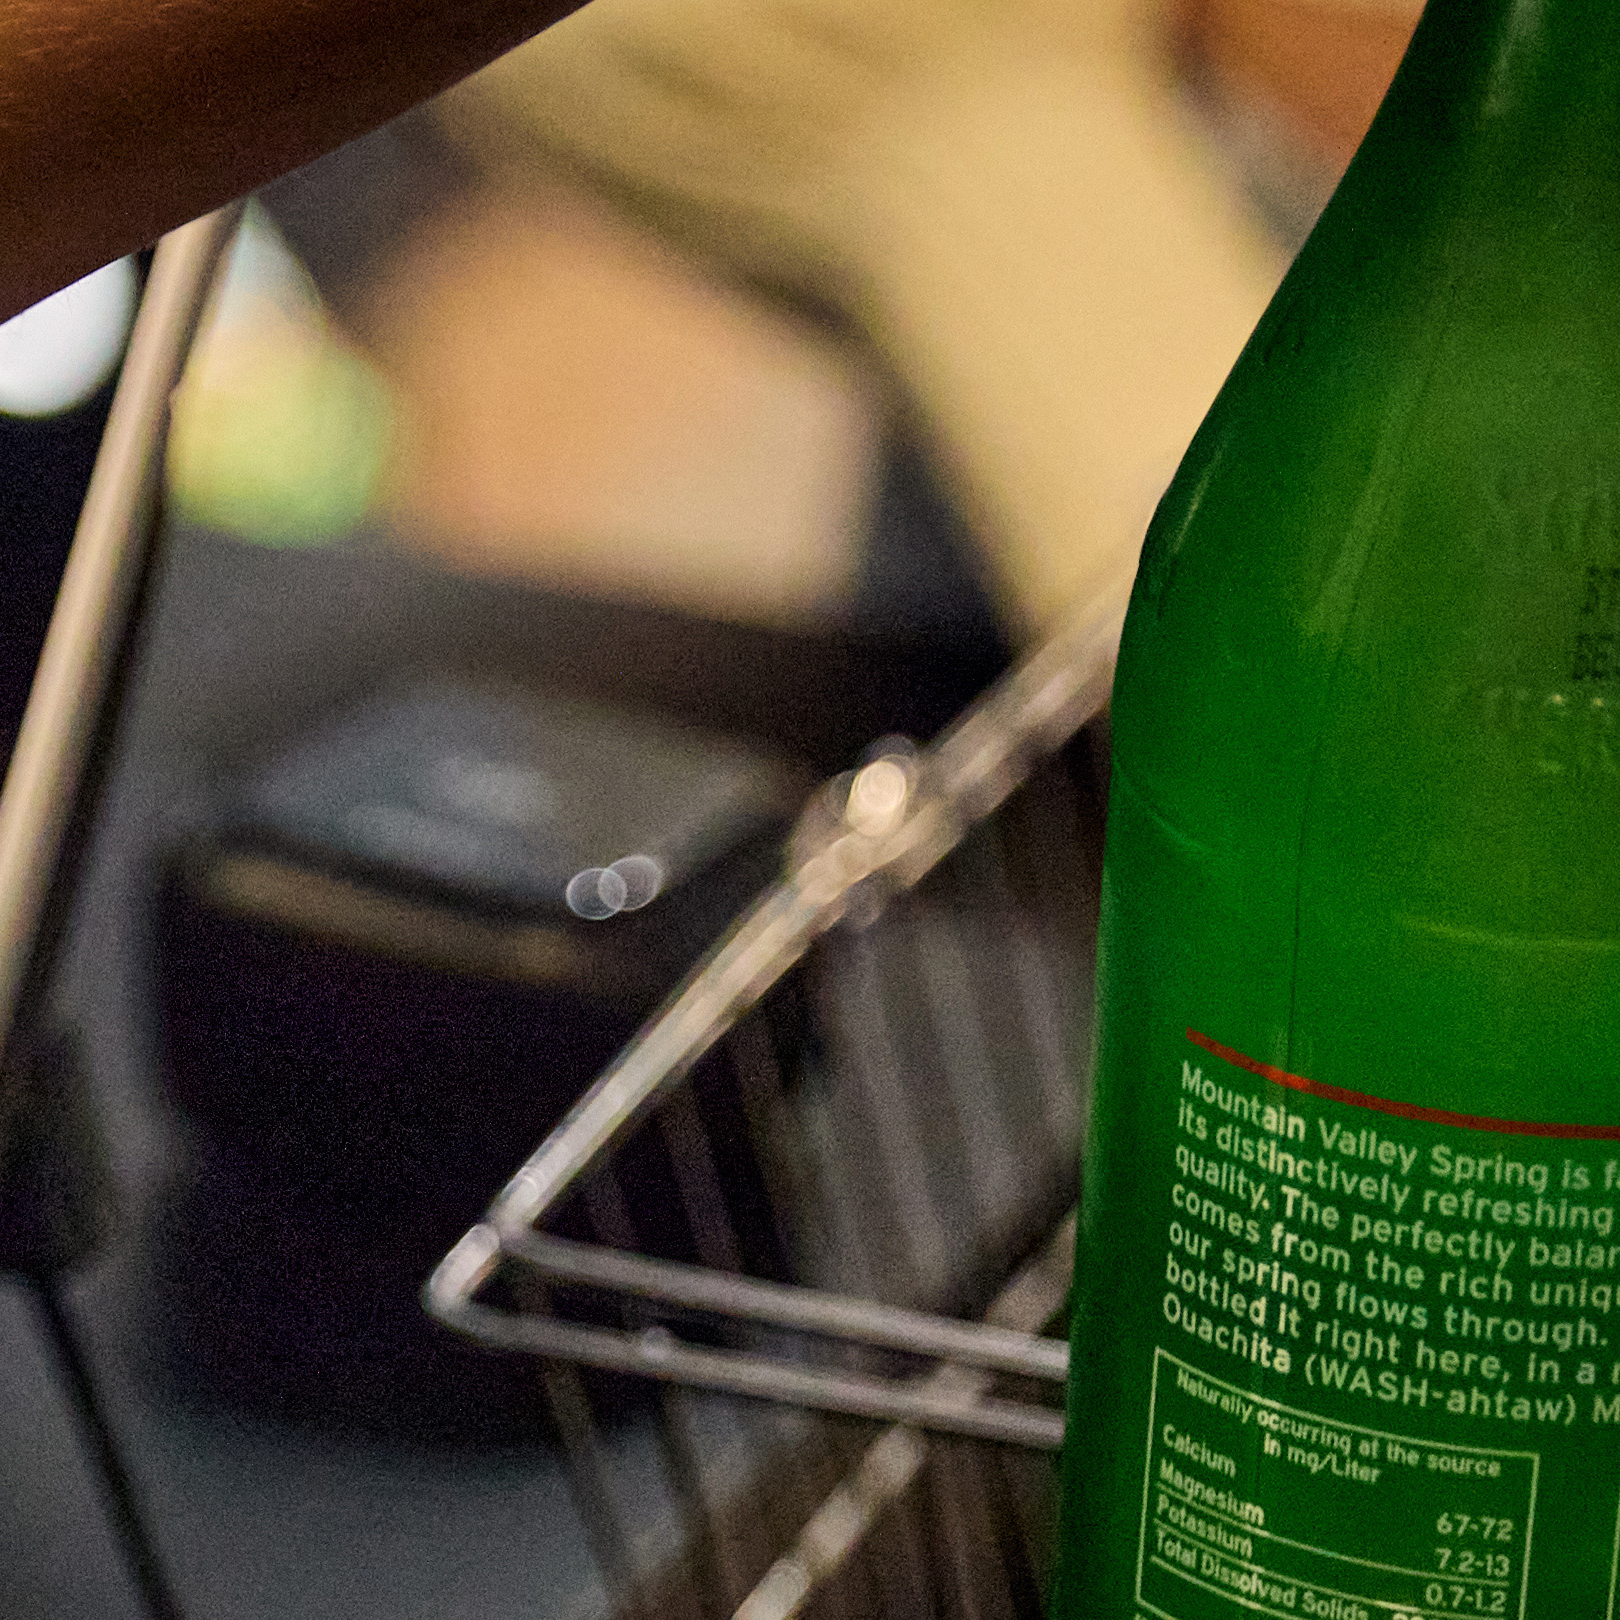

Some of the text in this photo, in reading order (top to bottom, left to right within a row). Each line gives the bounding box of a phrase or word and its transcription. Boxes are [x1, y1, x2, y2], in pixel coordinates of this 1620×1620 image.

[1178, 1098, 1207, 1141] its
[1216, 1124, 1411, 1214] distinctively
[1422, 1188, 1613, 1238] refreshing
[1182, 1060, 1306, 1142] Mountain
[1318, 1117, 1417, 1175] Valley
[1430, 1144, 1549, 1194] Spring
[1561, 1158, 1591, 1190] is
[1172, 1183, 1260, 1244] comes
[1271, 1222, 1351, 1273] from
[1365, 1249, 1425, 1289] the
[1439, 1266, 1513, 1302] rich
[1176, 1144, 1270, 1211] quality.
[1281, 1184, 1340, 1229] The
[1351, 1213, 1516, 1271] perfectly
[1166, 1252, 1266, 1327] bottled
[1278, 1302, 1301, 1338] it
[1315, 1319, 1401, 1365] right
[1416, 1339, 1510, 1384] here,
[1528, 1352, 1561, 1383] in
[1575, 1361, 1596, 1385] a
[1169, 1221, 1211, 1261] our
[1222, 1247, 1321, 1310] spring
[1336, 1281, 1428, 1329] flows
[1444, 1304, 1608, 1352] through.
[1163, 1292, 1291, 1374] Ouachita
[1305, 1354, 1576, 1426] (WASH-ahtaw)
[1163, 1423, 1514, 1542] Calcium 67-72
[1178, 1368, 1501, 1477] Naturally occurring at the source
[1287, 1445, 1381, 1484] mg/Liter
[1155, 1528, 1197, 1569] Total
[1200, 1546, 1297, 1608] Dissolved
[1156, 1493, 1253, 1558] Potassium
[1159, 1457, 1511, 1578] Magnesium 7.2-13
